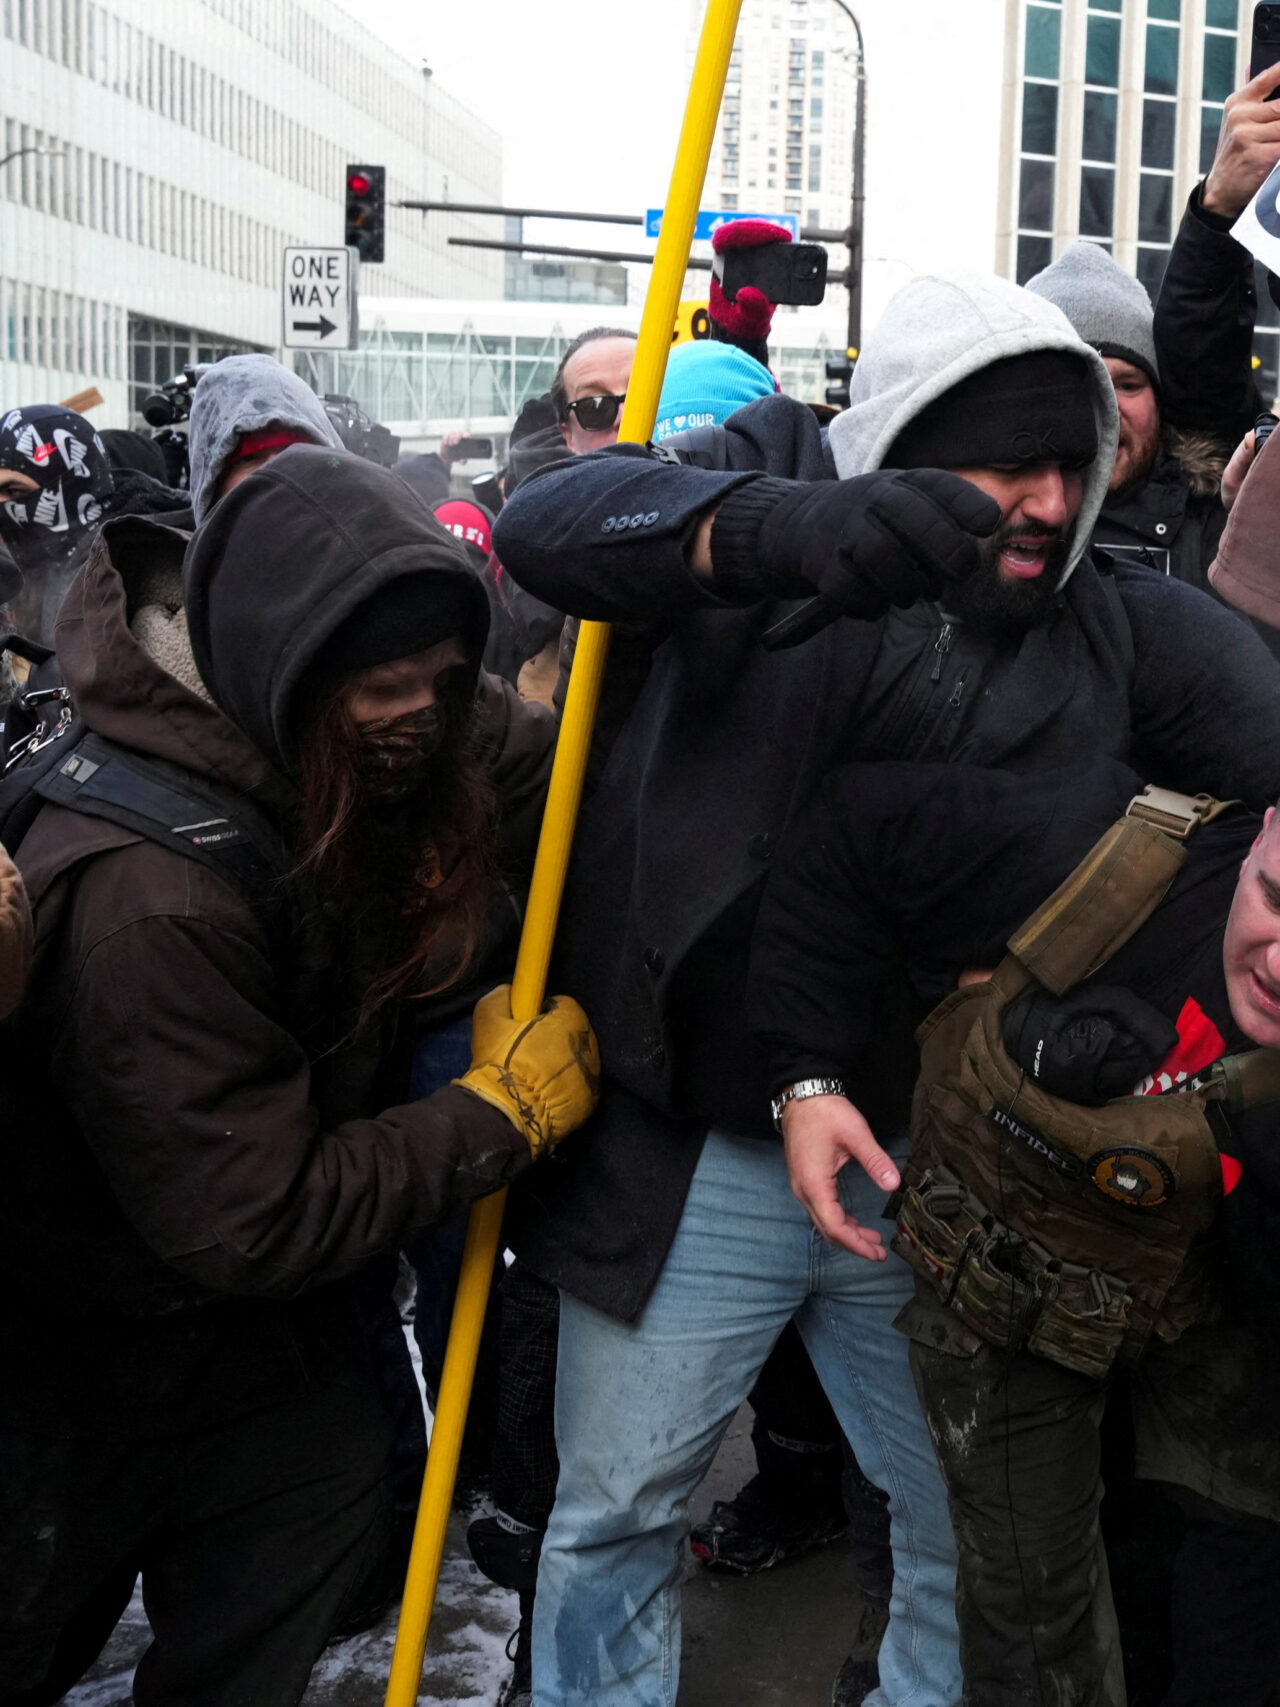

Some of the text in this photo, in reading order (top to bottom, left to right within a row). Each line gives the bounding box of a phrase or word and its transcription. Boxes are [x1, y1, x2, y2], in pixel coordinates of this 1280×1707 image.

[292, 255, 340, 279] ONE
[290, 284, 341, 308] WAY
[656, 413, 715, 433] WE OUR
[1034, 1039, 1044, 1078] HEAD
[994, 1110, 1077, 1172] INFIDEL
